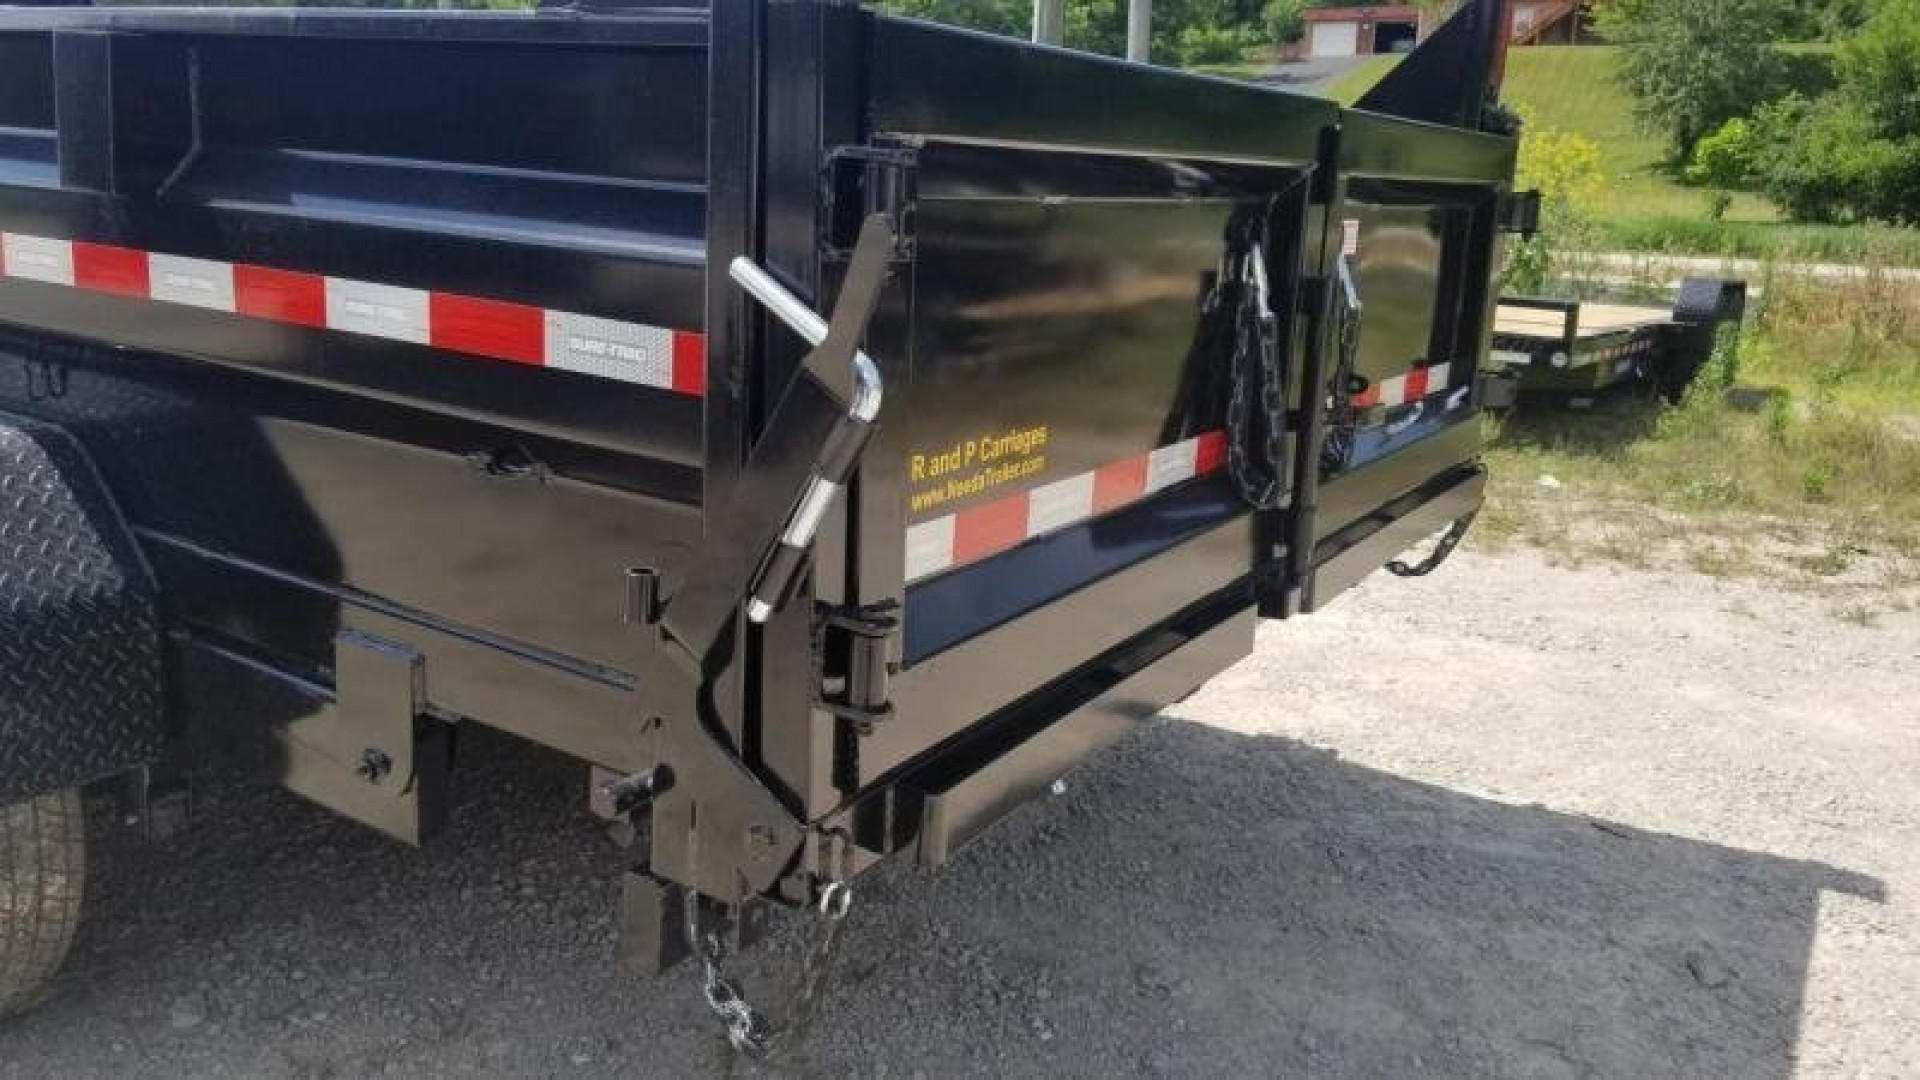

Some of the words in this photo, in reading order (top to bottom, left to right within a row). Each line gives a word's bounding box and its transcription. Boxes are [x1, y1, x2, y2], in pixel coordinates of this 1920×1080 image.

[911, 454, 925, 480] R
[930, 444, 961, 476] and
[965, 440, 976, 466] P
[980, 425, 1048, 462] Carriages
